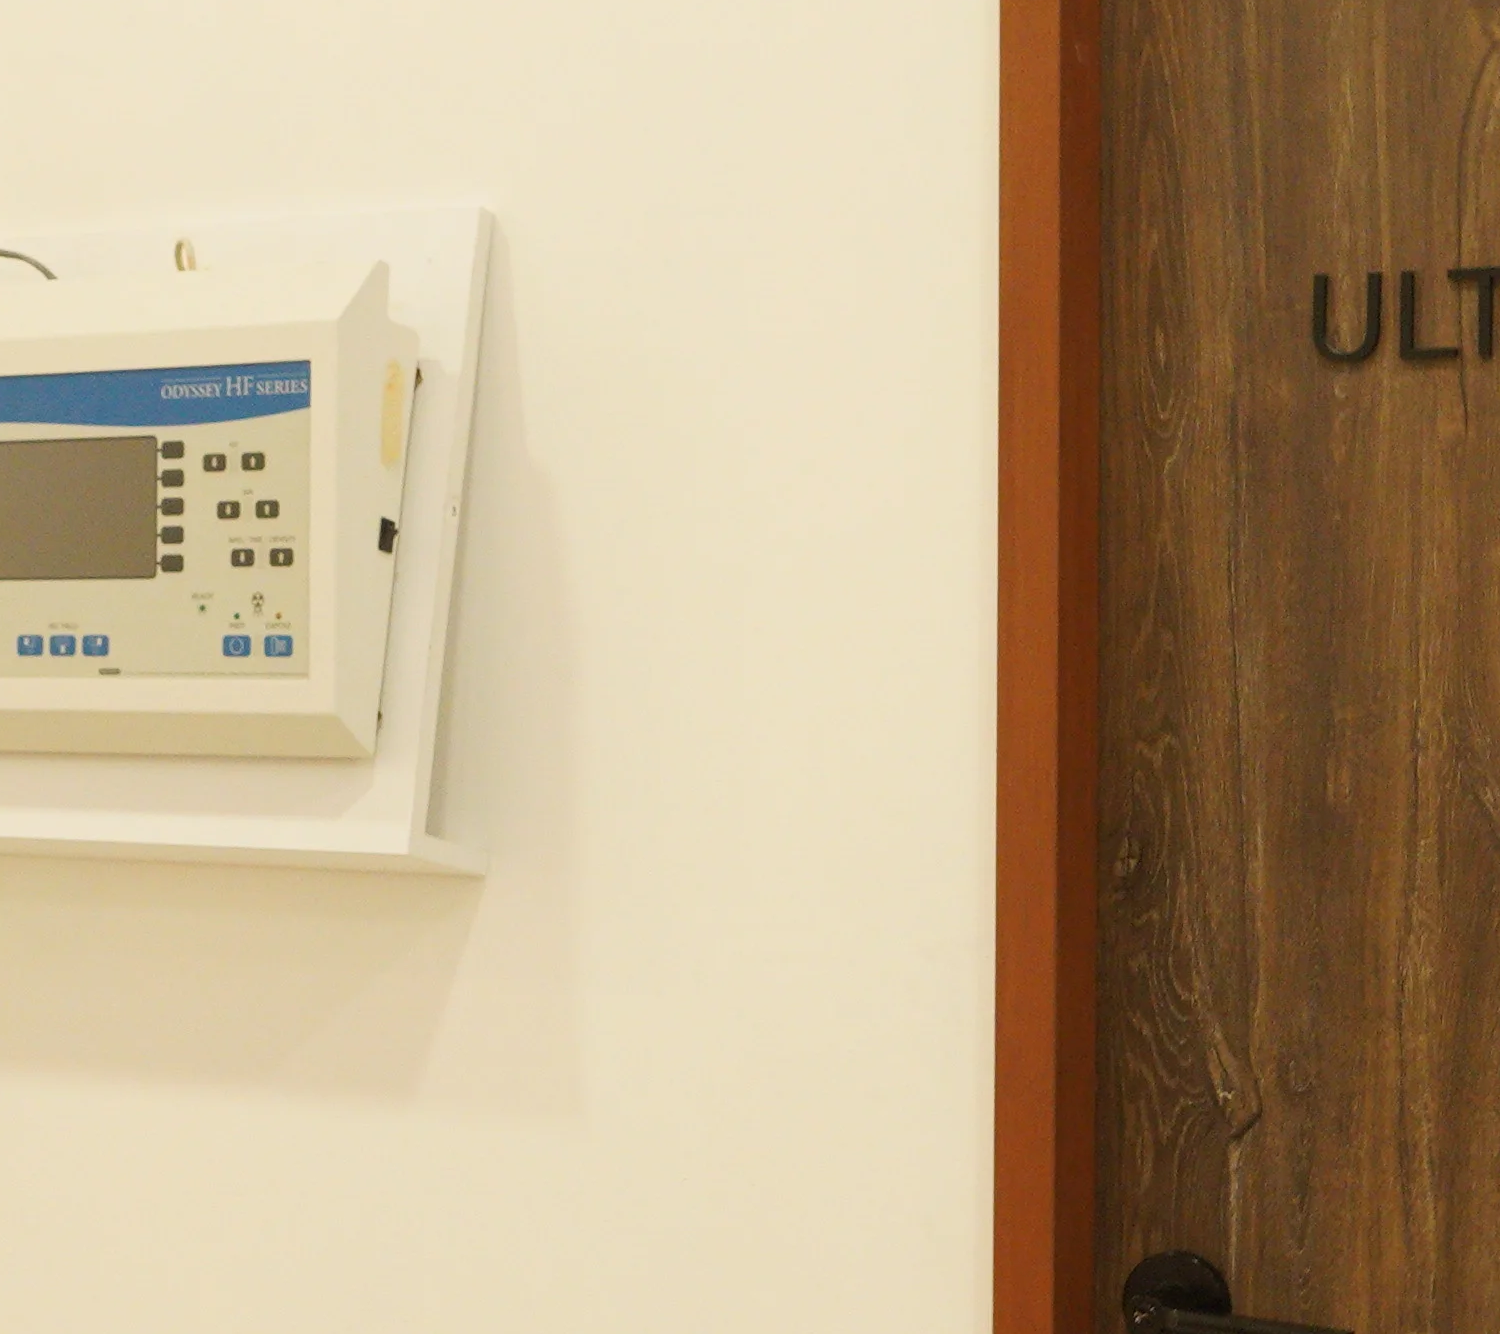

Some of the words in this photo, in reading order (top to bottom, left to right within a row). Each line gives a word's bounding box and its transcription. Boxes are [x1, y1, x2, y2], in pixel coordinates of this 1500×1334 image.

[160, 382, 222, 400] ODYSSEY
[226, 375, 254, 397] HF
[256, 378, 308, 396] SERIES
